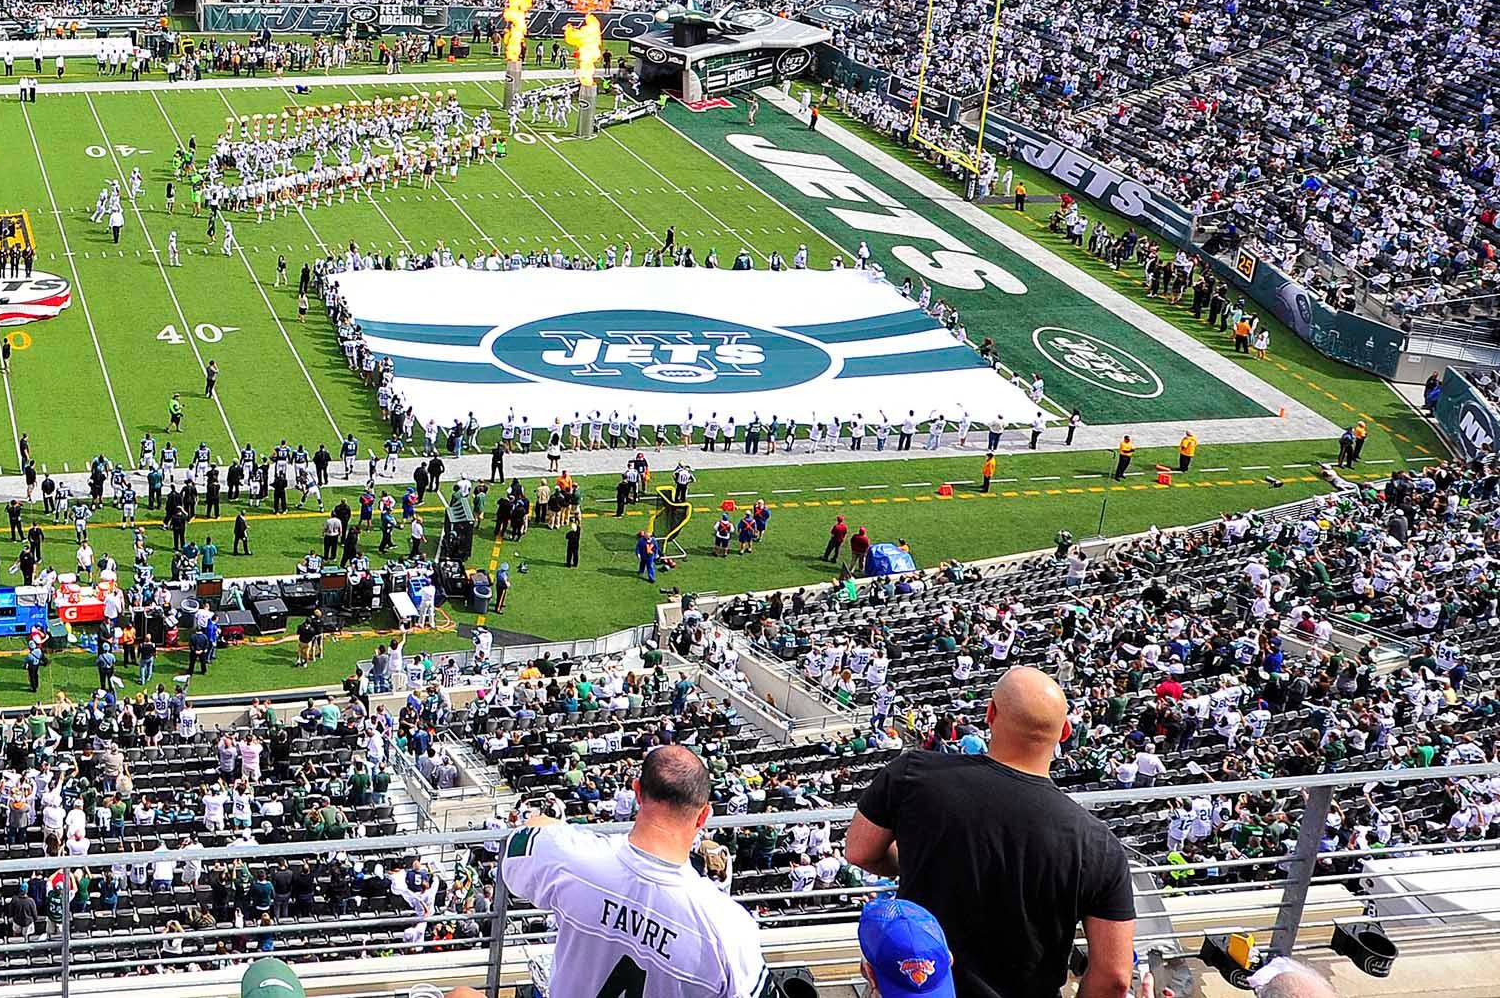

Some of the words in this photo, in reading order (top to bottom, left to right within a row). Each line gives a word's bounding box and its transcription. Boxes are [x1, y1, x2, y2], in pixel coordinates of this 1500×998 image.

[726, 67, 756, 84] jetBlue
[1021, 142, 1152, 217] JETS
[725, 134, 1028, 295] JETS
[1238, 254, 1254, 275] 25
[155, 323, 224, 345] 40
[541, 338, 767, 366] JETS
[1460, 410, 1493, 449] NY
[64, 606, 78, 619] G
[600, 898, 678, 960] FAVRE
